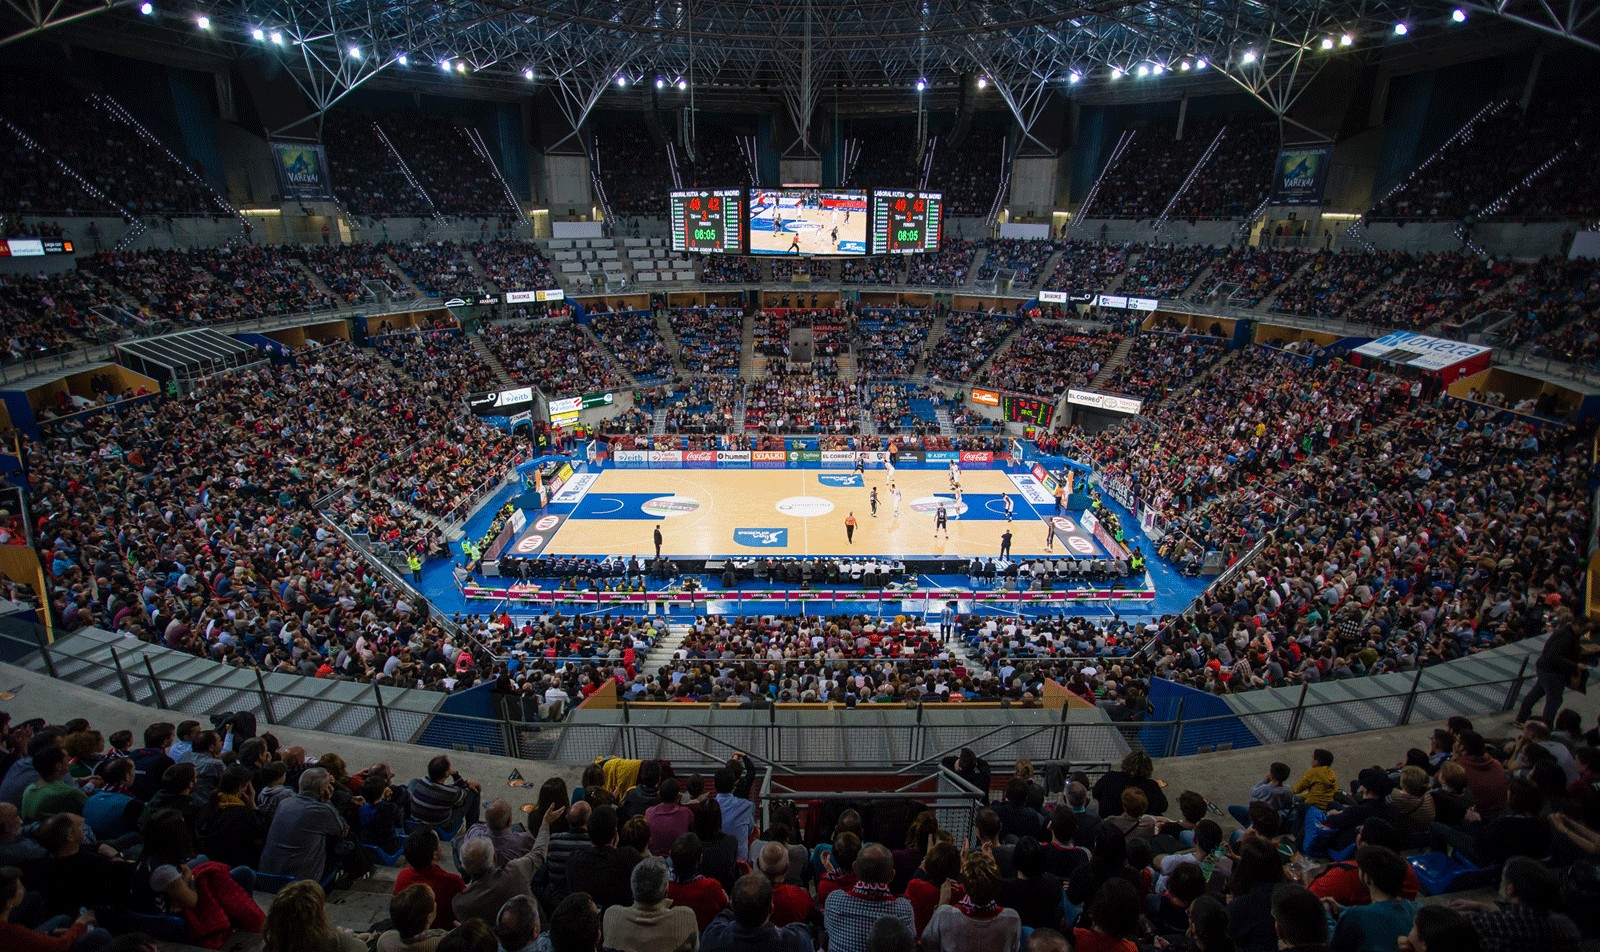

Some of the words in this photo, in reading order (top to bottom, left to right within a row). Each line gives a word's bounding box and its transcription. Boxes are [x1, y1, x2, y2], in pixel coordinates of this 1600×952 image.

[288, 172, 318, 182] VAREKAI
[1284, 178, 1314, 188] VAREKAI
[707, 197, 720, 211] 42
[913, 199, 925, 213] 42
[701, 210, 708, 222] 3
[906, 211, 913, 223] 3
[694, 229, 716, 240] 08:05
[897, 230, 919, 241] 08:05
[513, 393, 529, 401] eitb
[1076, 394, 1101, 403] CORREO
[1119, 400, 1139, 408] TOYOTA
[627, 453, 643, 461] eitb
[686, 451, 713, 461] Coca-Cola
[724, 452, 750, 460] hummel
[963, 452, 989, 462] Coca-Cola
[538, 517, 557, 529] KIA
[521, 537, 540, 550] KIA
[1070, 538, 1090, 551] KIA
